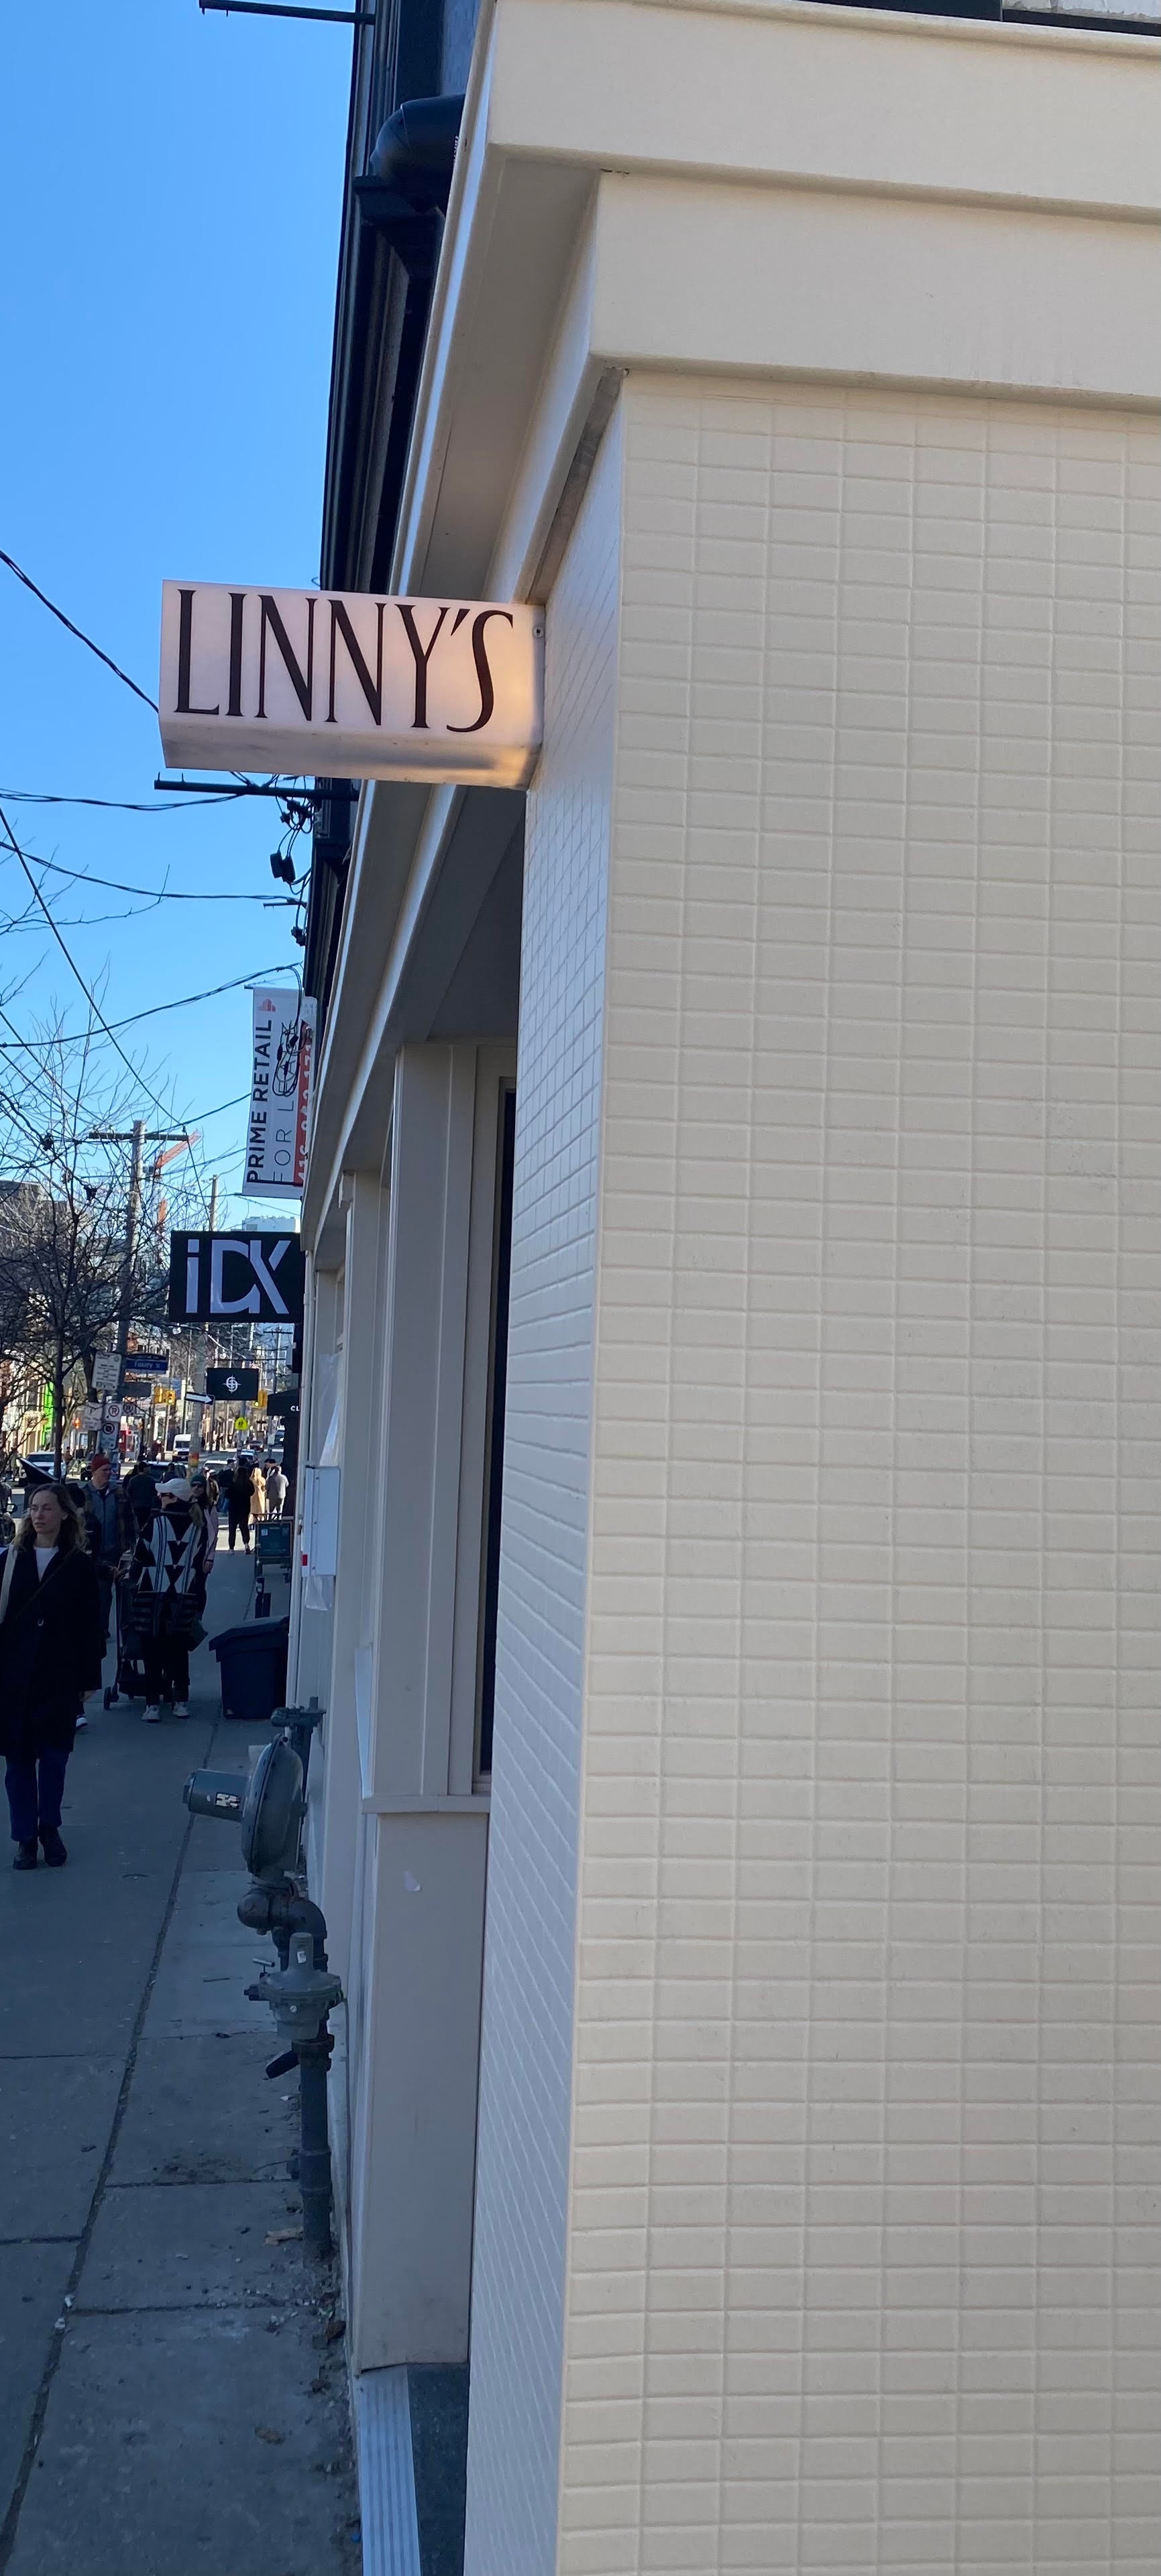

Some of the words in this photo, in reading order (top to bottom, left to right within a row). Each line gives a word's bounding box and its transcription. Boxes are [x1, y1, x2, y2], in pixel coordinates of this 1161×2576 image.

[173, 589, 514, 733] LINNY'S
[252, 1019, 272, 1102] RETAIL
[246, 1111, 267, 1183] PRIME
[273, 1128, 292, 1182] FOR
